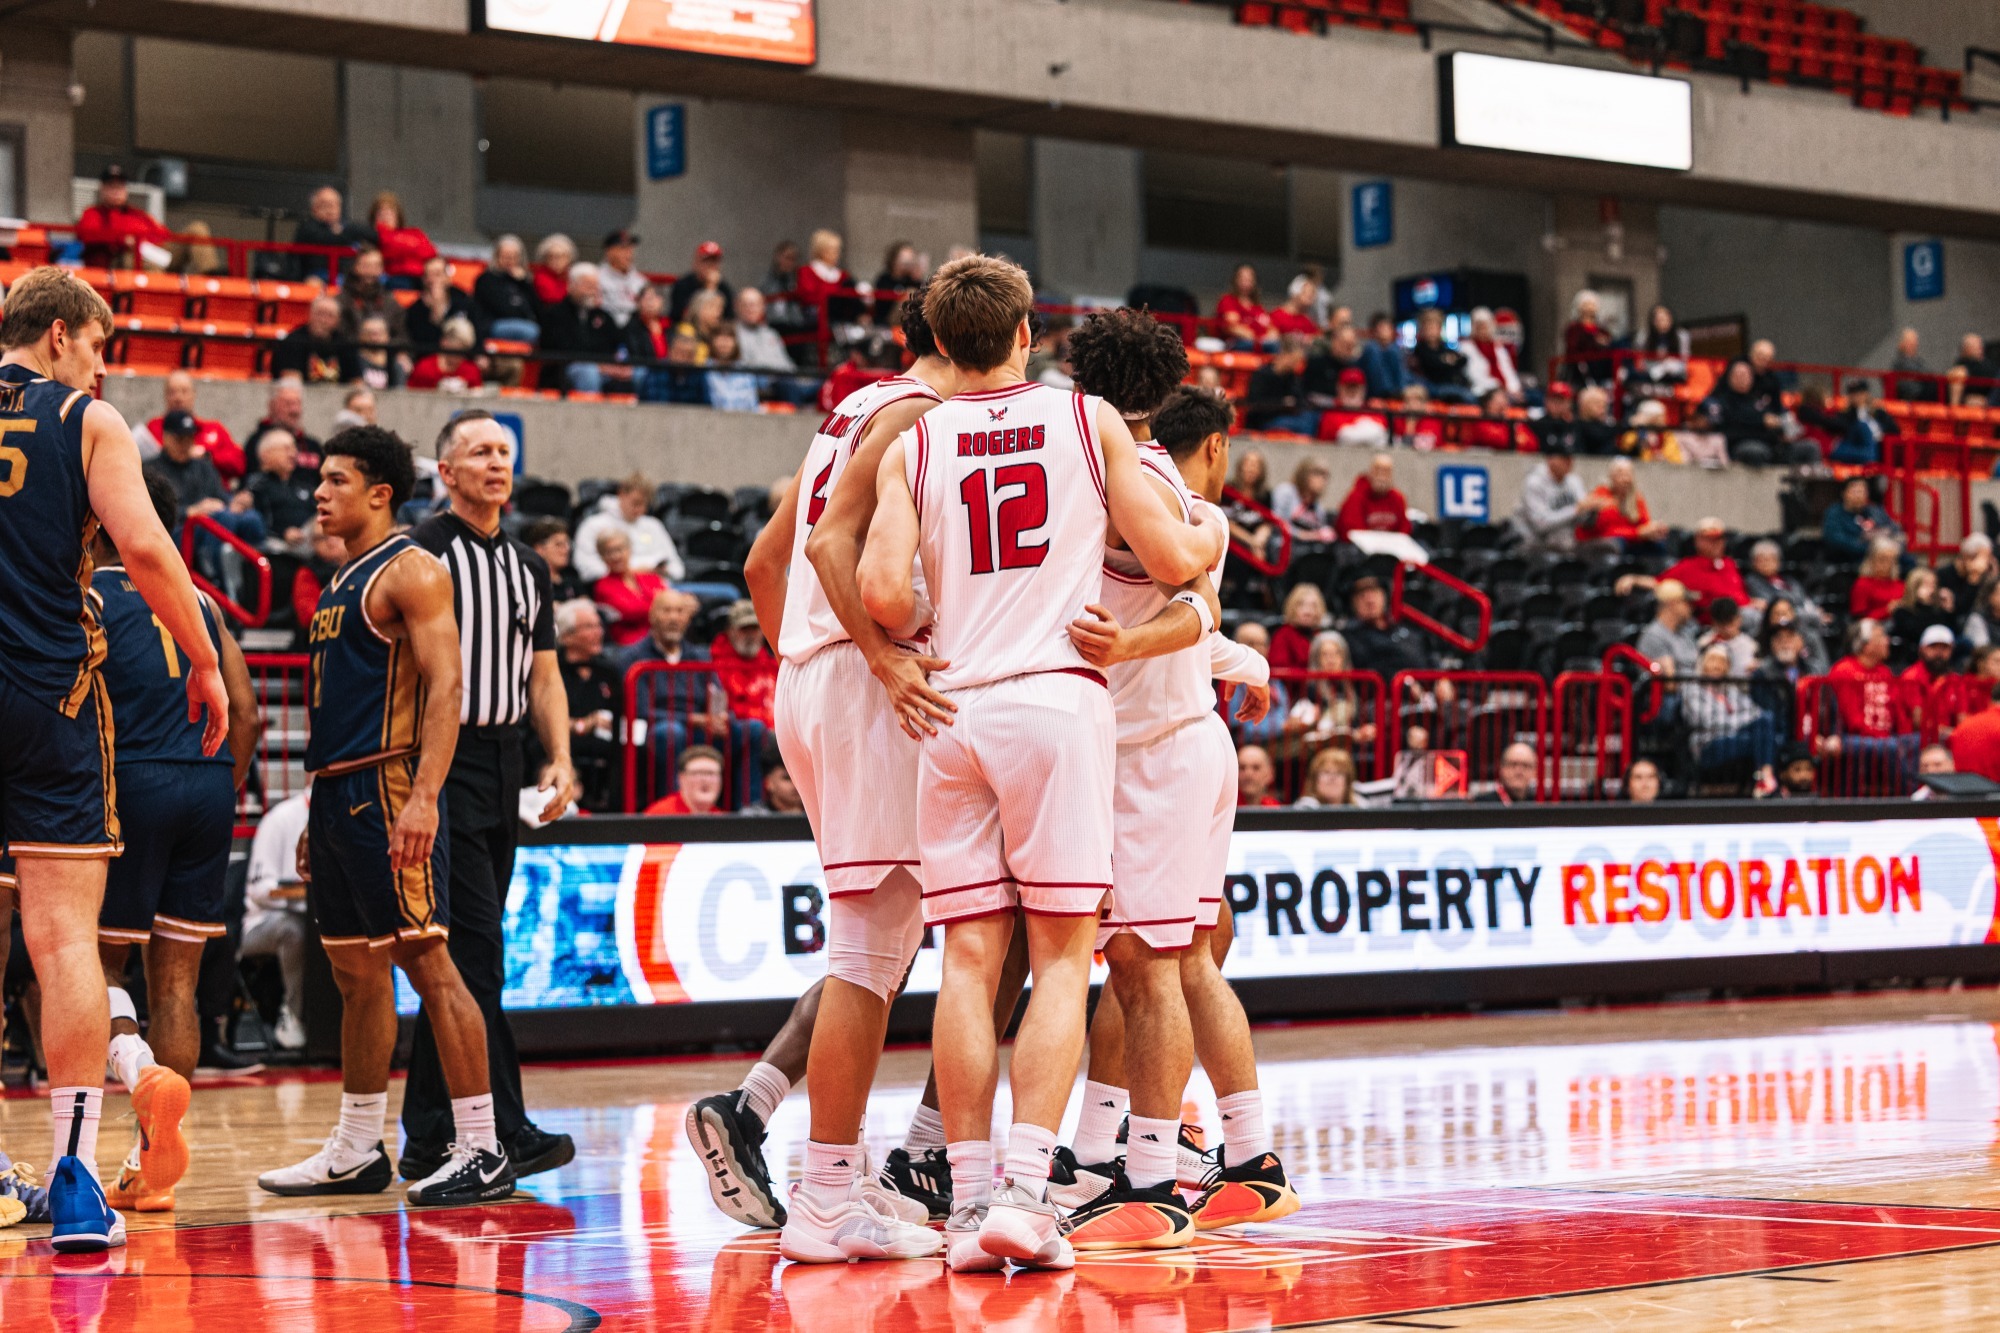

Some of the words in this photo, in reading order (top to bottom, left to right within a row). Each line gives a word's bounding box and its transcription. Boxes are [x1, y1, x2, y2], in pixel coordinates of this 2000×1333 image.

[654, 111, 674, 149] E
[1361, 187, 1380, 220] F
[957, 424, 1045, 457] ROGERS
[1443, 473, 1487, 516] LE
[960, 462, 1050, 575] 12
[309, 605, 346, 644] CBU
[1224, 866, 1541, 937] PROPERTY
[1561, 855, 1921, 925] RESTORATION
